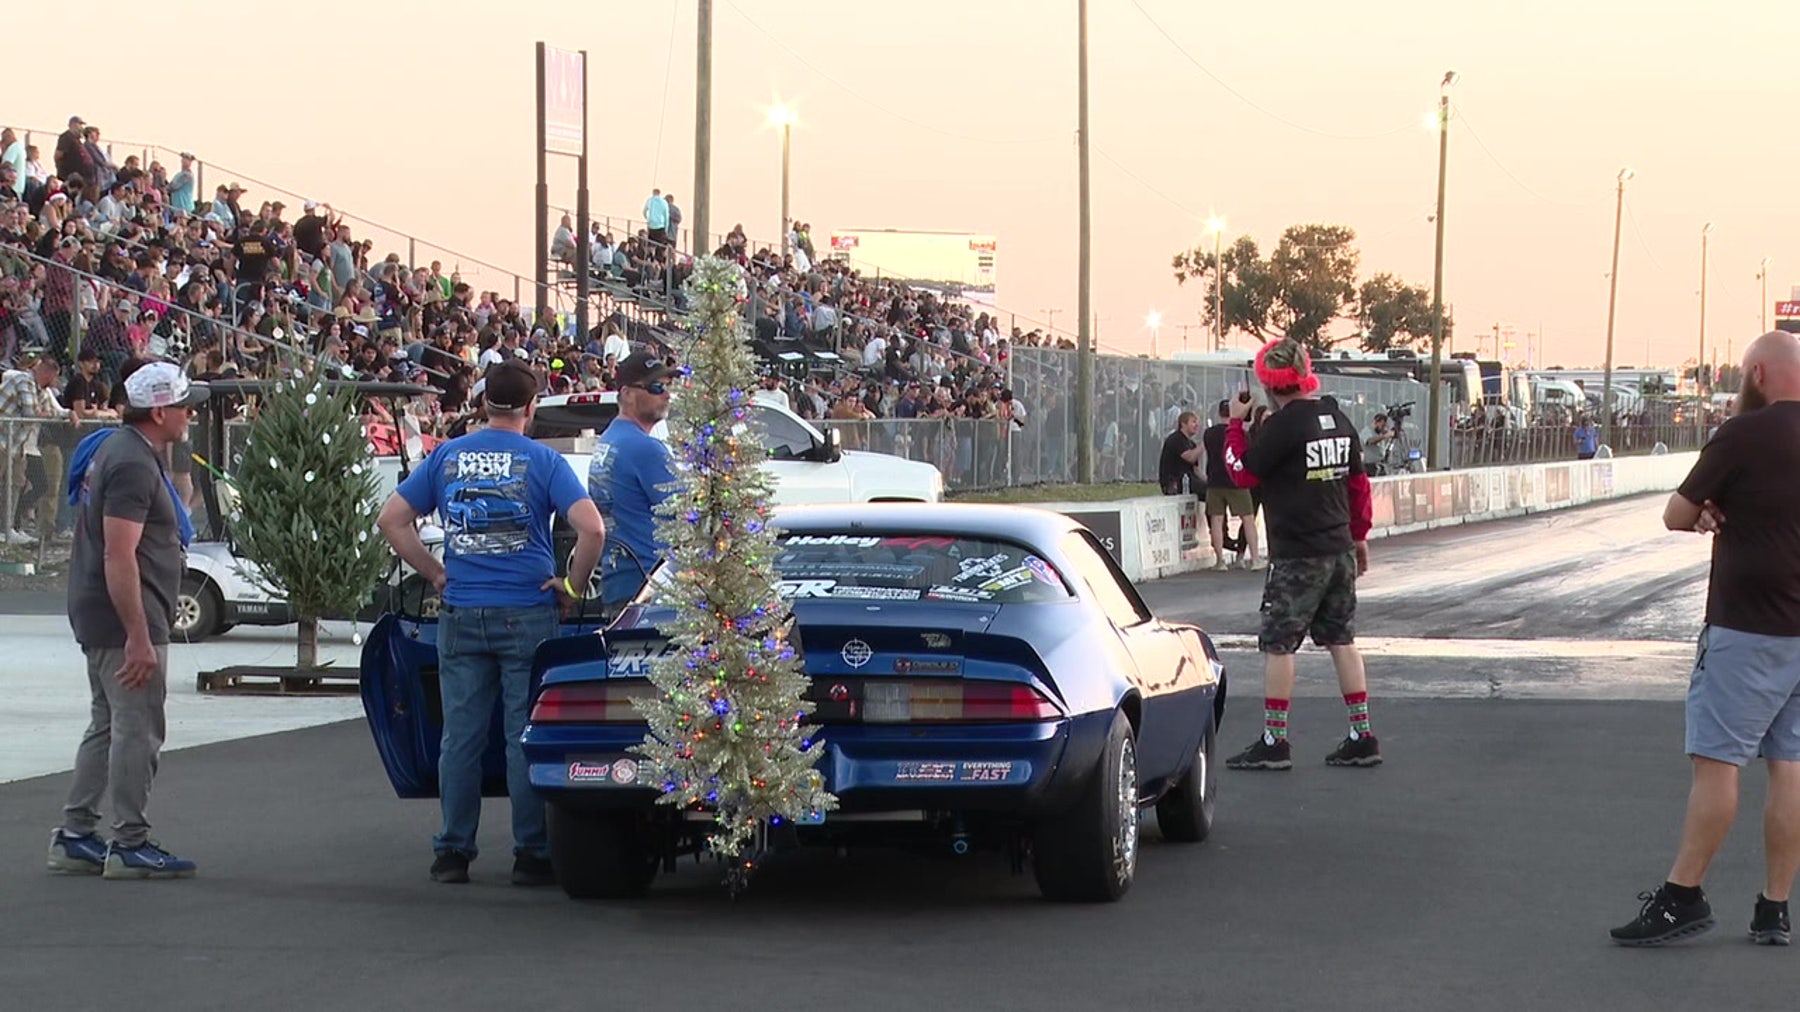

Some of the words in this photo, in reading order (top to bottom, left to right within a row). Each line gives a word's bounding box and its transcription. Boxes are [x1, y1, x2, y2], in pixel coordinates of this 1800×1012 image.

[458, 452, 512, 462] SOCCER
[1306, 437, 1351, 468] STAFF
[457, 460, 511, 479] MOM
[785, 535, 881, 548] Holley
[237, 604, 269, 615] YAMAHA
[963, 762, 1012, 770] EVERYTHING
